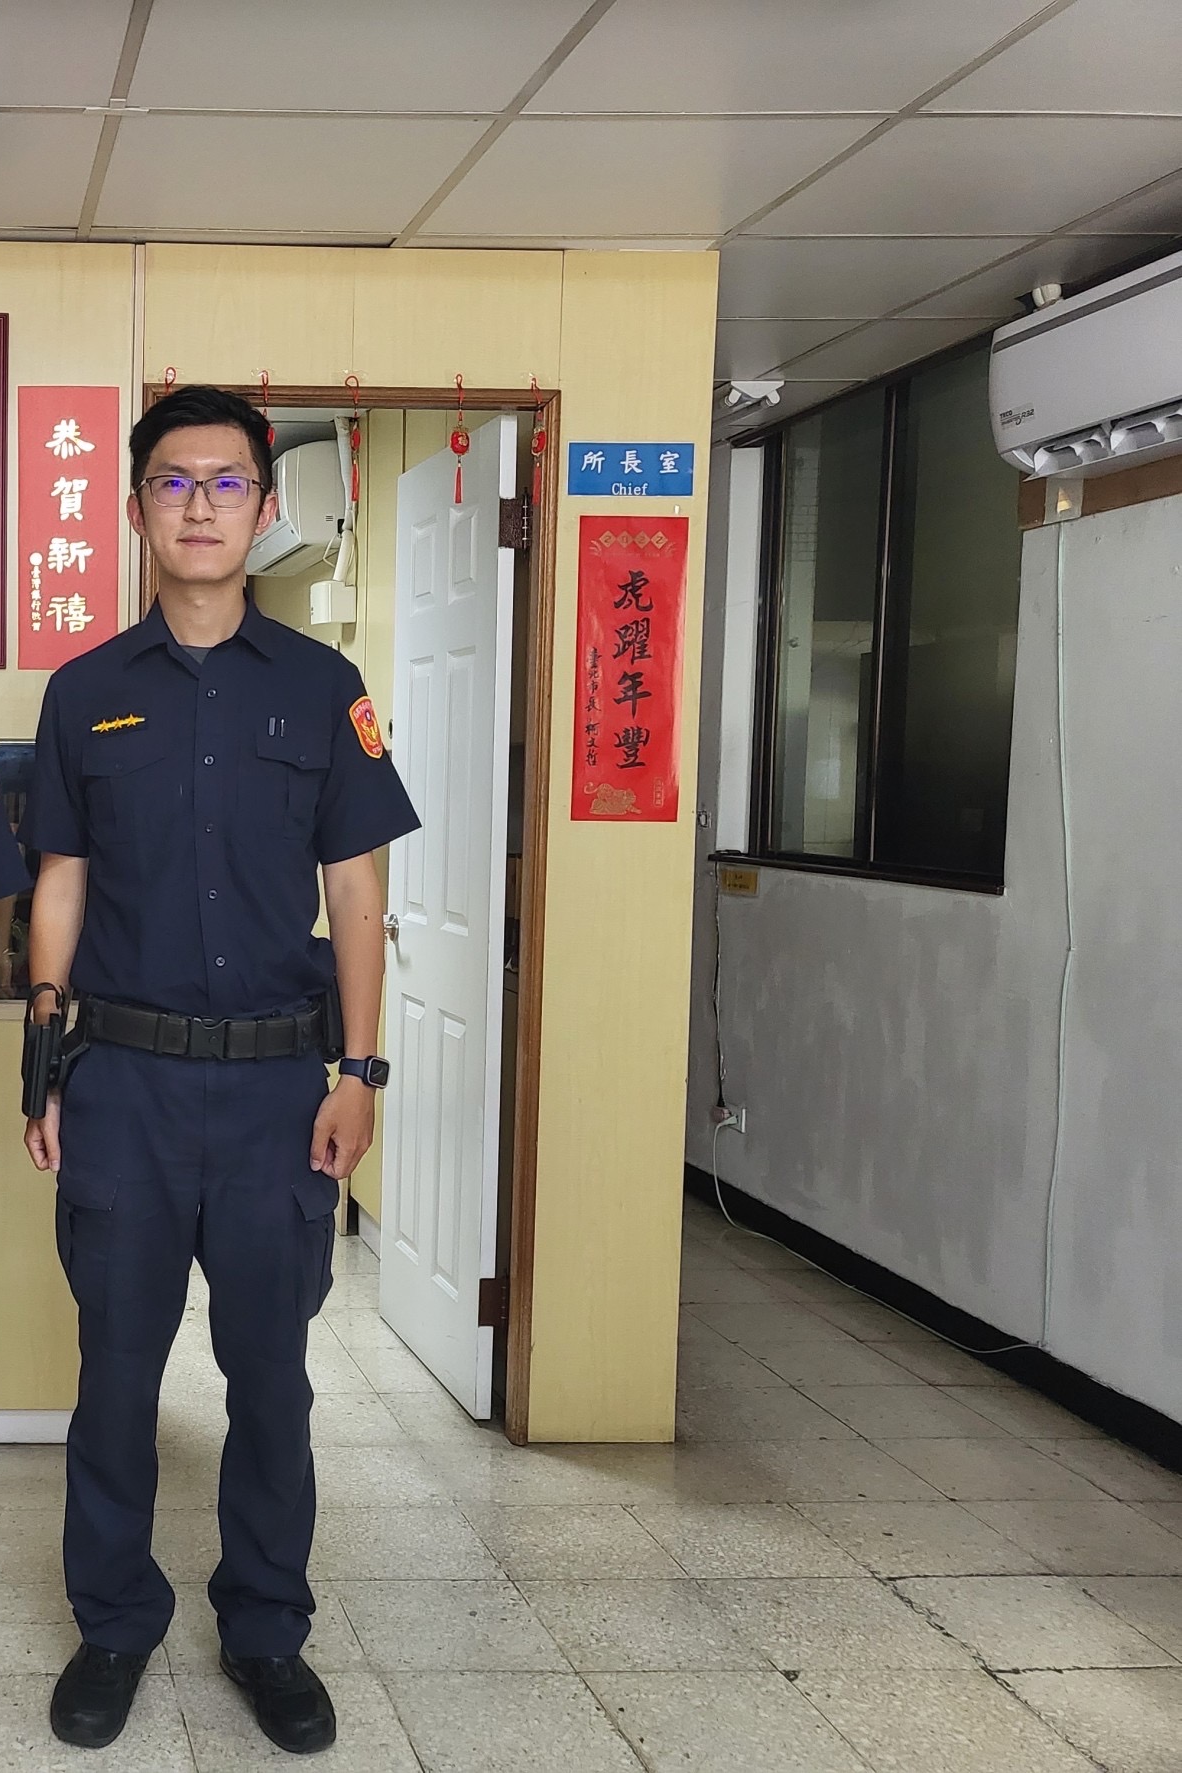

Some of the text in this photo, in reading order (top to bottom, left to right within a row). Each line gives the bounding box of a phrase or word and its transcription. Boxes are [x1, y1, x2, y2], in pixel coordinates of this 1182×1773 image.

[580, 450, 681, 475] 所長室
[611, 482, 649, 496] Chief
[44, 418, 96, 634] 恭賀新禧
[602, 533, 665, 546] 2022
[612, 569, 654, 770] 虎躍年豐
